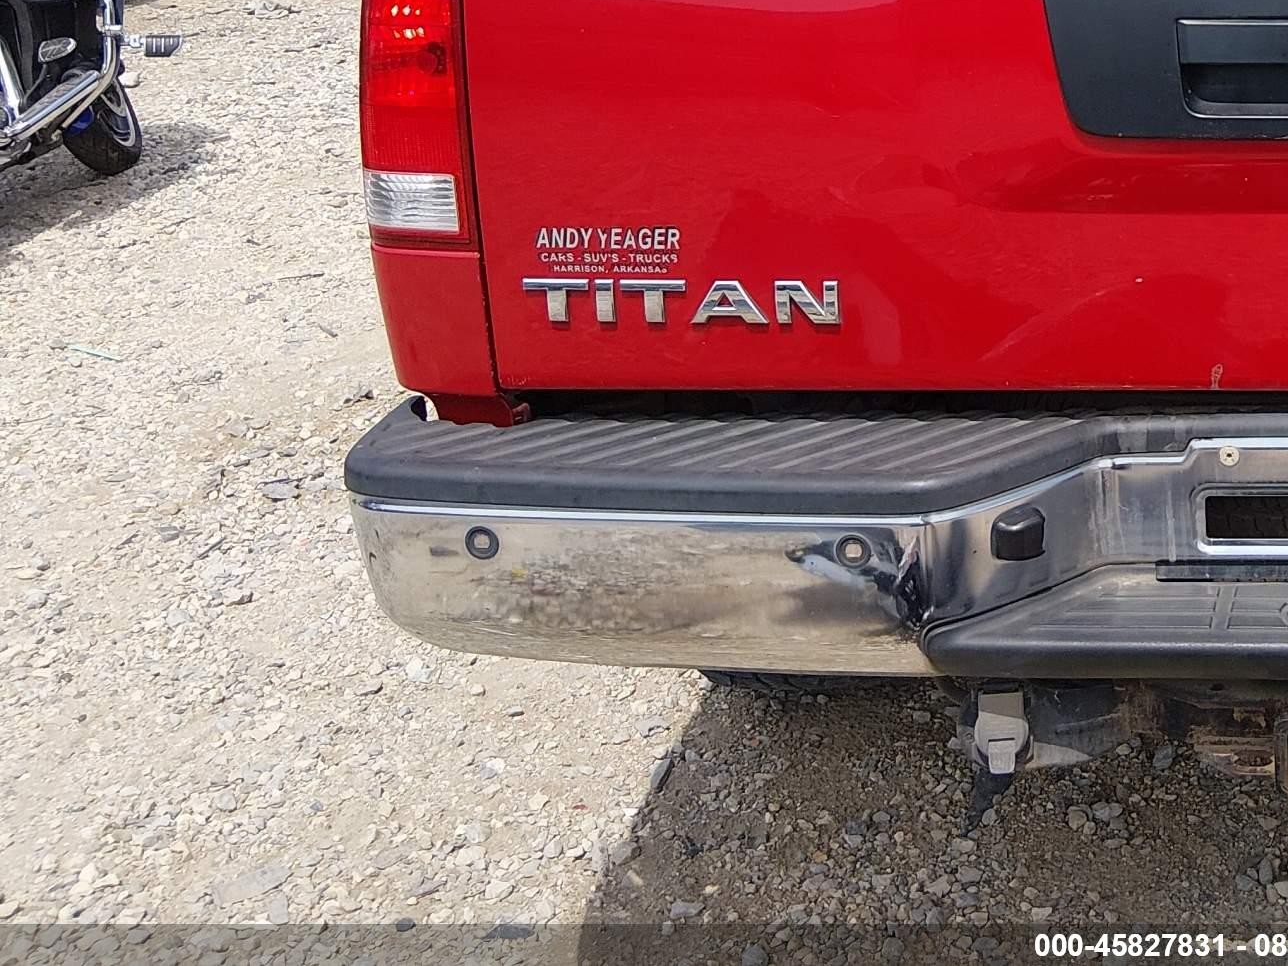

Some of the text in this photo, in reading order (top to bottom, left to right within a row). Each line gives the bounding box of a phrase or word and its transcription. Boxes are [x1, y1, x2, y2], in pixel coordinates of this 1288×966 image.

[536, 227, 680, 250] ANDY YEAGER
[541, 252, 575, 263] CARS
[583, 252, 619, 263] SUV'S
[629, 253, 678, 263] TRUCKS
[553, 265, 609, 274] HARRISON,
[522, 278, 842, 324] TITAN
